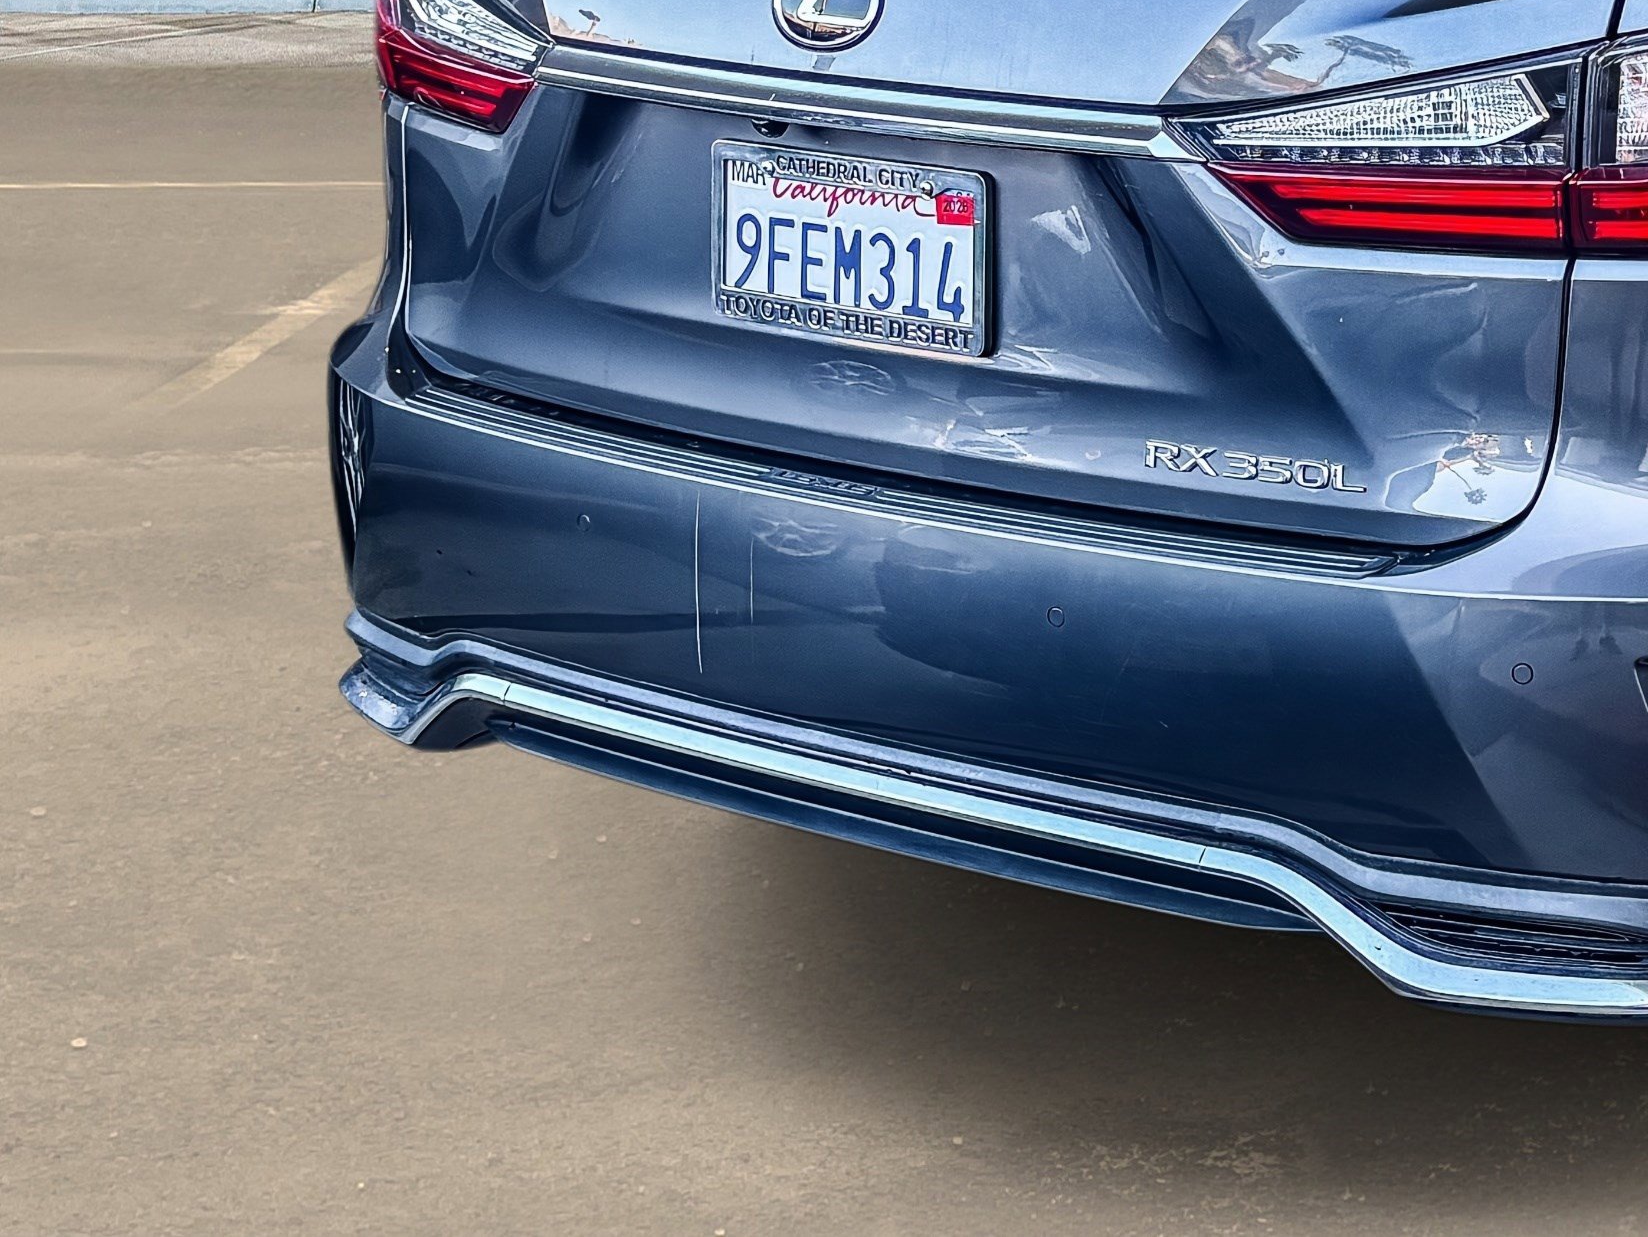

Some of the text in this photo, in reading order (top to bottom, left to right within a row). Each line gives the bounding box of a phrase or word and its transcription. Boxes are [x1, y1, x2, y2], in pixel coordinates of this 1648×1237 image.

[776, 154, 922, 189] CATHEDRAL CITY
[734, 212, 965, 322] 9FEM314
[721, 295, 974, 352] TOYOTA OF THE DESERT
